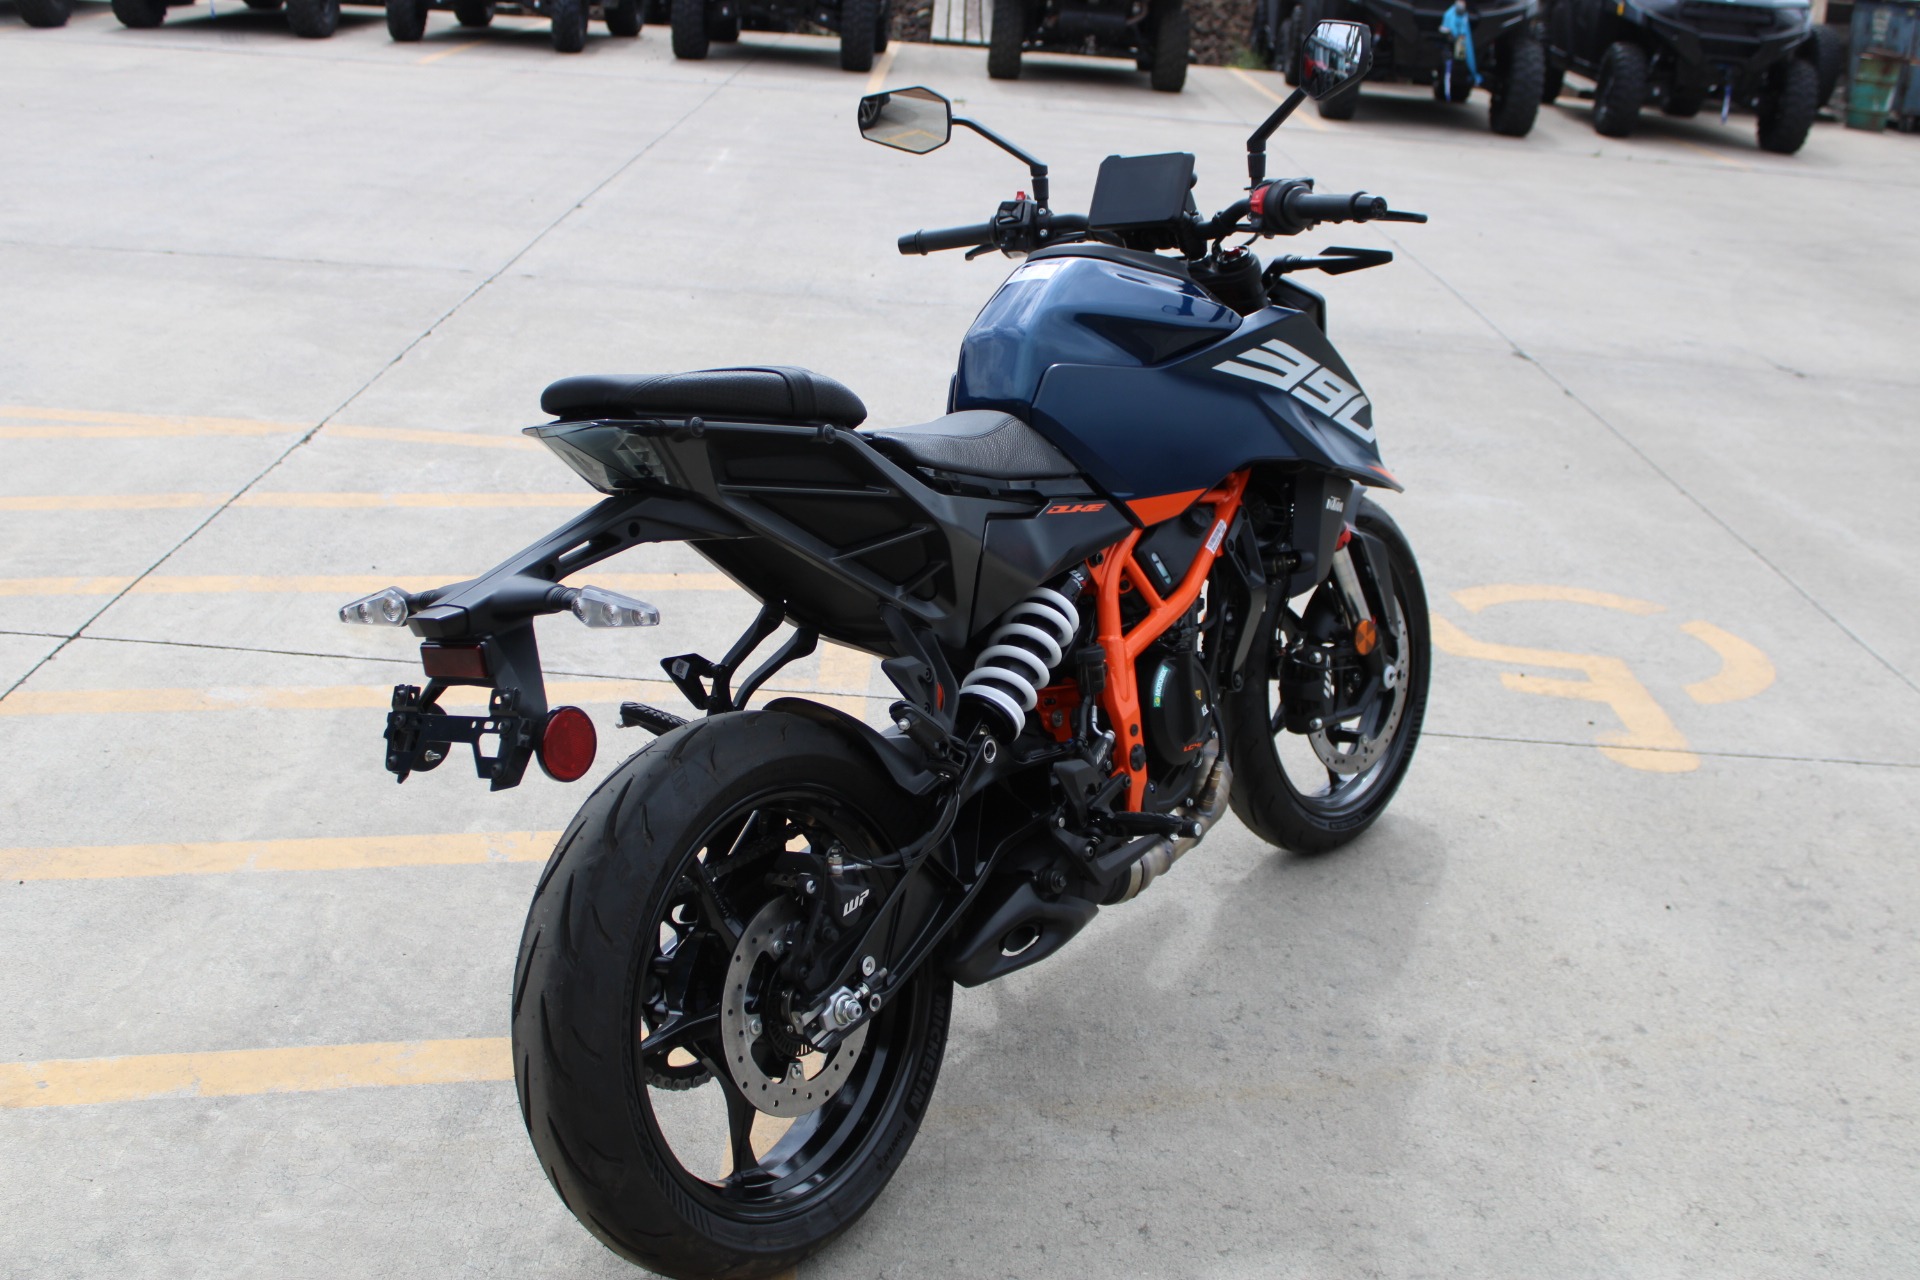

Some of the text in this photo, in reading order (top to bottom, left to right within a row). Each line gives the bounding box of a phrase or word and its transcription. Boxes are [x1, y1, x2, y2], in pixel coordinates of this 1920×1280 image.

[1046, 503, 1107, 514] DUKE
[1155, 667, 1169, 697] MOTOREX
[842, 889, 870, 917] WP
[910, 995, 947, 1111] MICHELIN
